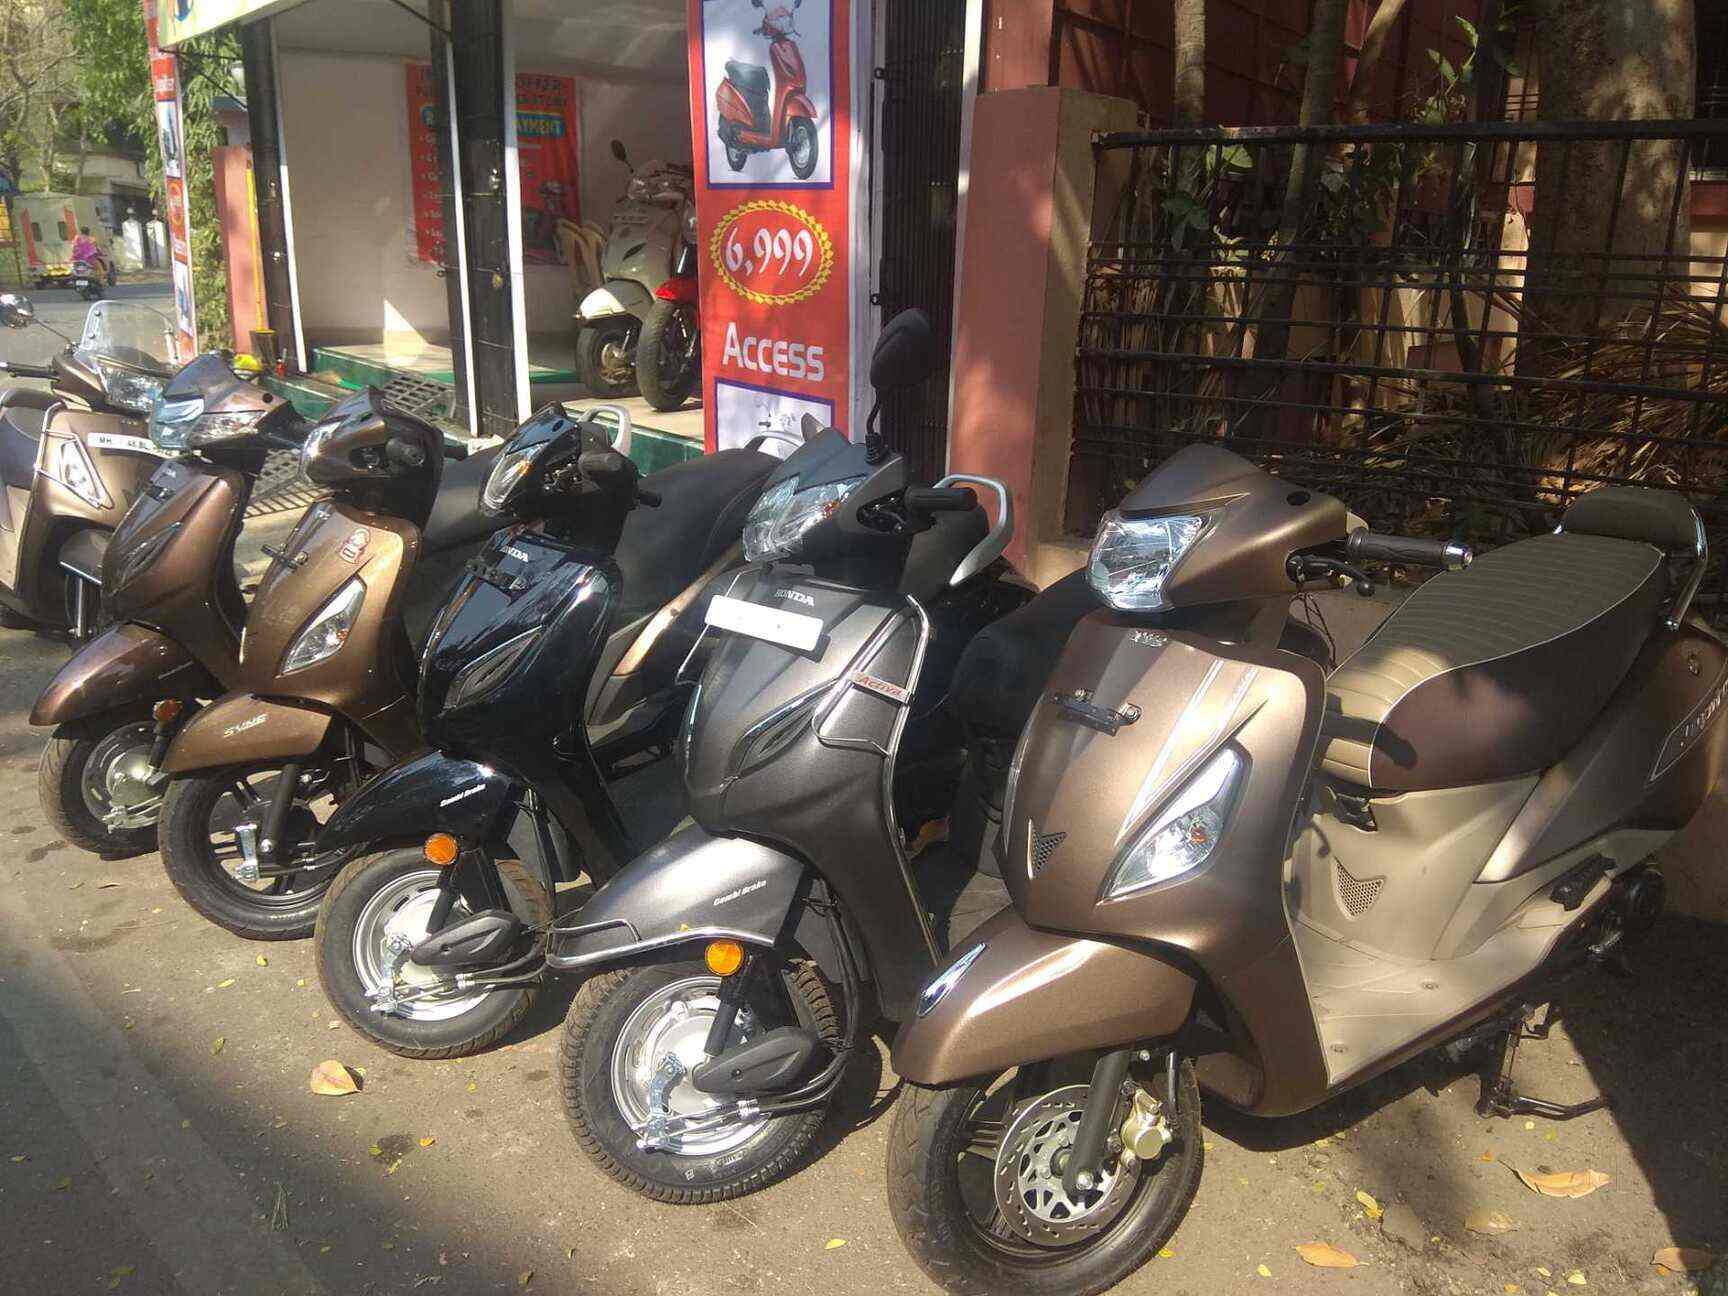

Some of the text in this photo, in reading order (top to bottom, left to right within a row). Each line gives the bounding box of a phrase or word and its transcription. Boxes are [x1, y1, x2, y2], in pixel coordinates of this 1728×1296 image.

[512, 118, 562, 137] AYMENT
[725, 226, 813, 276] 6,999
[774, 588, 816, 607] HONDA
[713, 879, 767, 906] Combi Brake
